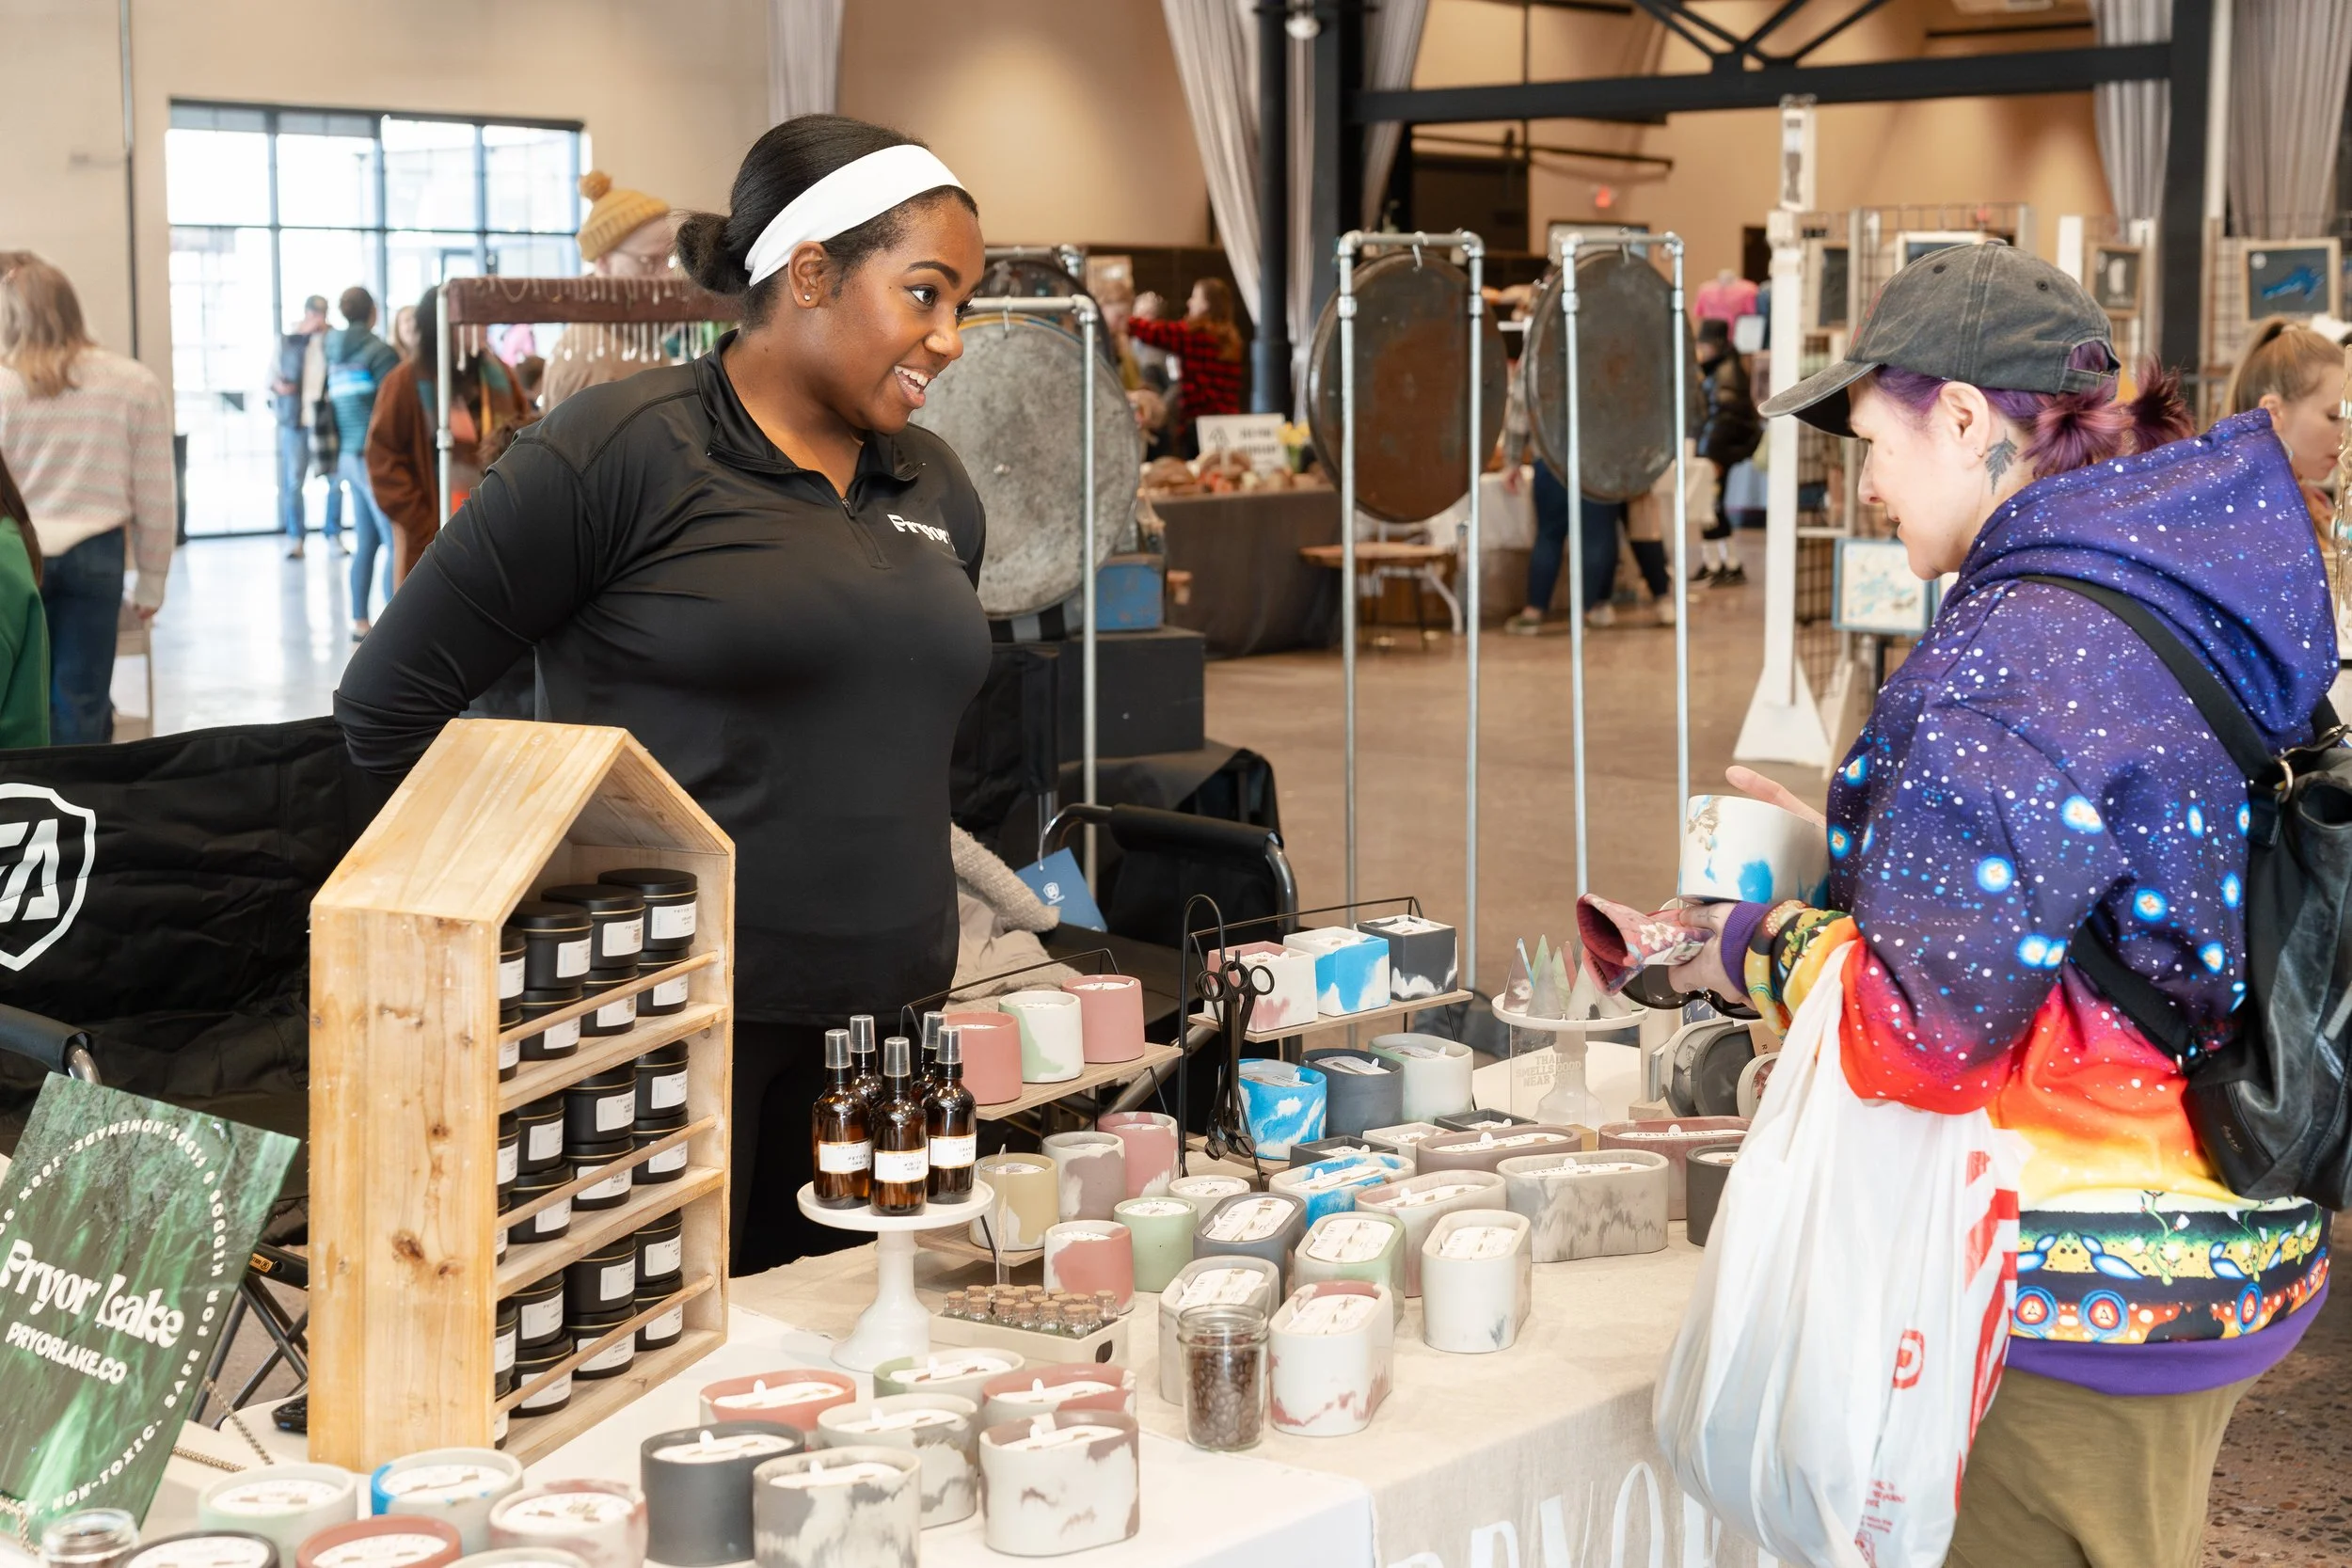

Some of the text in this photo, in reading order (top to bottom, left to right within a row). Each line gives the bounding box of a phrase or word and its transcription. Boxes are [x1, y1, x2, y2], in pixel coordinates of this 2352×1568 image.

[1516, 1065, 1555, 1078] SMELLS
[1535, 1054, 1565, 1066] THAT
[0, 1239, 185, 1349] Pryor Lake
[164, 1349, 200, 1409] SAFE
[197, 1290, 220, 1337] FOR
[211, 1189, 227, 1277] KIDDOS
[5, 1322, 128, 1386] PRYORLAKE.CO
